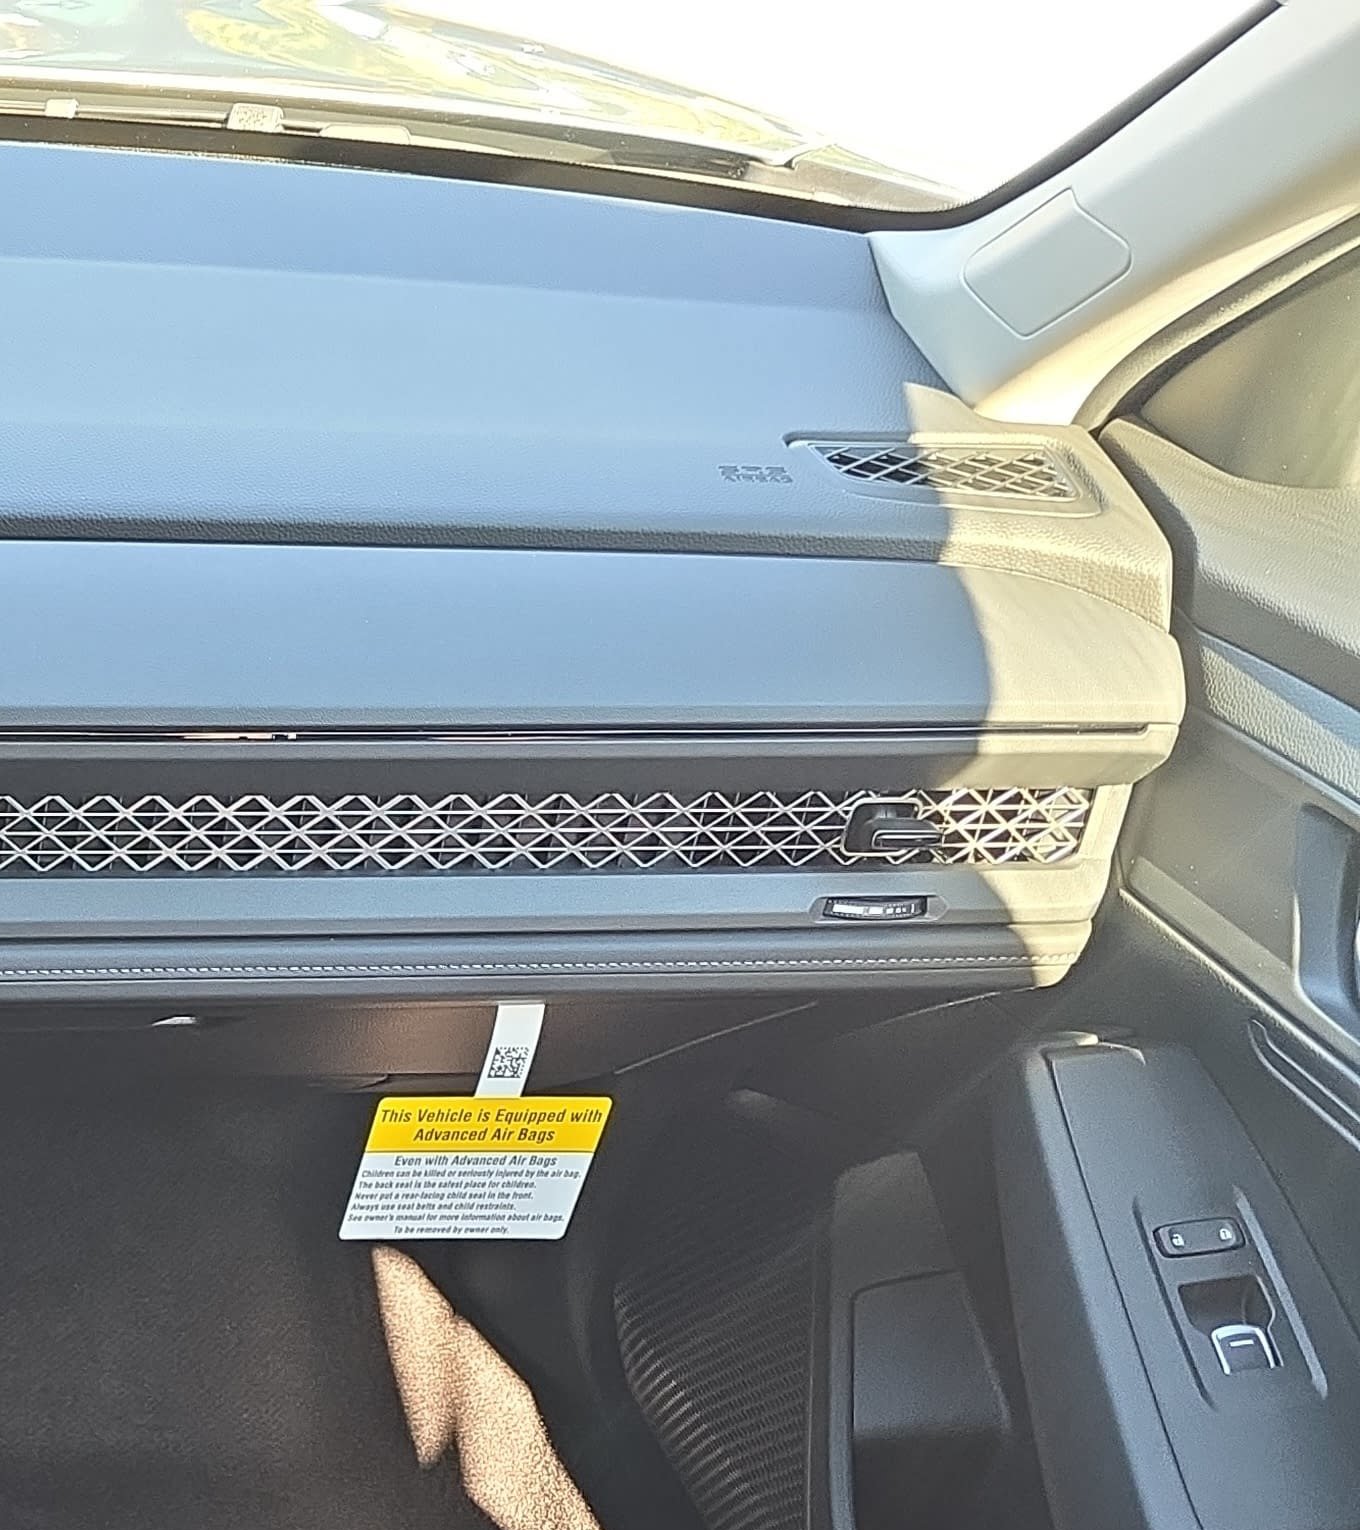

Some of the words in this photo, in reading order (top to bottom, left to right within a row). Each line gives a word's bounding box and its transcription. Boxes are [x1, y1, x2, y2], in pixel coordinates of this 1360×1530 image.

[381, 1108, 412, 1123] This
[418, 1108, 472, 1123] Vehicle
[477, 1109, 491, 1122] is
[495, 1108, 567, 1125] Equipped
[570, 1109, 603, 1123] with
[413, 1127, 488, 1142] Advanced
[491, 1128, 515, 1141] Air
[518, 1127, 556, 1144] Bags
[394, 1155, 421, 1166] Even
[425, 1156, 448, 1165] with
[451, 1155, 507, 1166] Advanced
[509, 1155, 527, 1165] Air
[528, 1155, 558, 1168] Bags
[361, 1170, 395, 1178] Children
[412, 1170, 422, 1178] be
[424, 1170, 446, 1178] killed
[457, 1170, 494, 1179] seriously
[495, 1169, 523, 1179] injured
[525, 1170, 536, 1179] by
[536, 1169, 548, 1178] the
[550, 1170, 563, 1178] air
[563, 1170, 581, 1179] bag.
[359, 1181, 373, 1189] The
[374, 1181, 394, 1189] back
[395, 1181, 413, 1189] seat
[414, 1181, 422, 1189] is
[423, 1181, 436, 1189] the
[438, 1181, 463, 1189] safest
[463, 1181, 487, 1189] place
[488, 1181, 500, 1189] for
[501, 1181, 537, 1189] children.
[355, 1192, 378, 1200] Never
[379, 1192, 393, 1201] put
[401, 1192, 445, 1201] rear-facing
[446, 1192, 467, 1200] child
[468, 1192, 486, 1200] seat
[487, 1192, 496, 1200] in
[497, 1192, 510, 1200] the
[511, 1192, 534, 1200] front.
[351, 1202, 379, 1211] Always
[416, 1202, 436, 1210] belts
[454, 1202, 475, 1210] child
[475, 1202, 517, 1210] restraints.
[453, 1226, 463, 1234] by
[490, 1226, 509, 1234] only.
